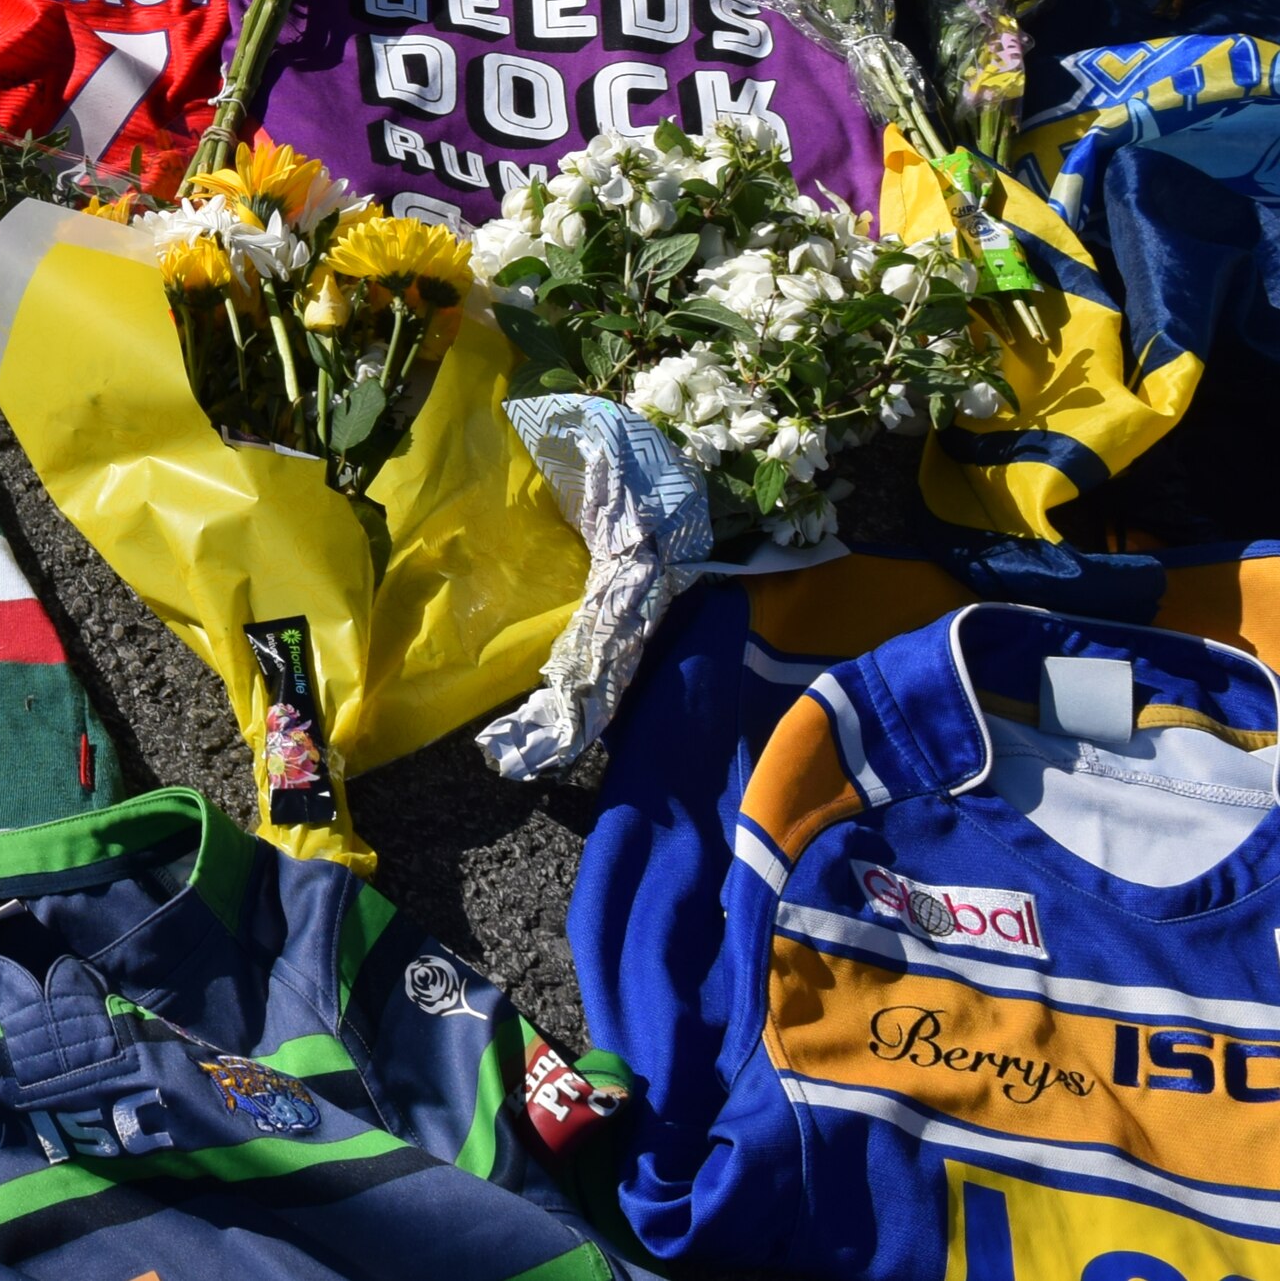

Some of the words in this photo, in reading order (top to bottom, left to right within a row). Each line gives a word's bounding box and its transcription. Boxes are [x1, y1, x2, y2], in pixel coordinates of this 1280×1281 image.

[370, 33, 793, 164] DOCK
[862, 867, 1042, 949] Global
[868, 1004, 1096, 1105] Berry's
[1112, 1023, 1280, 1104] ISC
[28, 1087, 175, 1166] ISC
